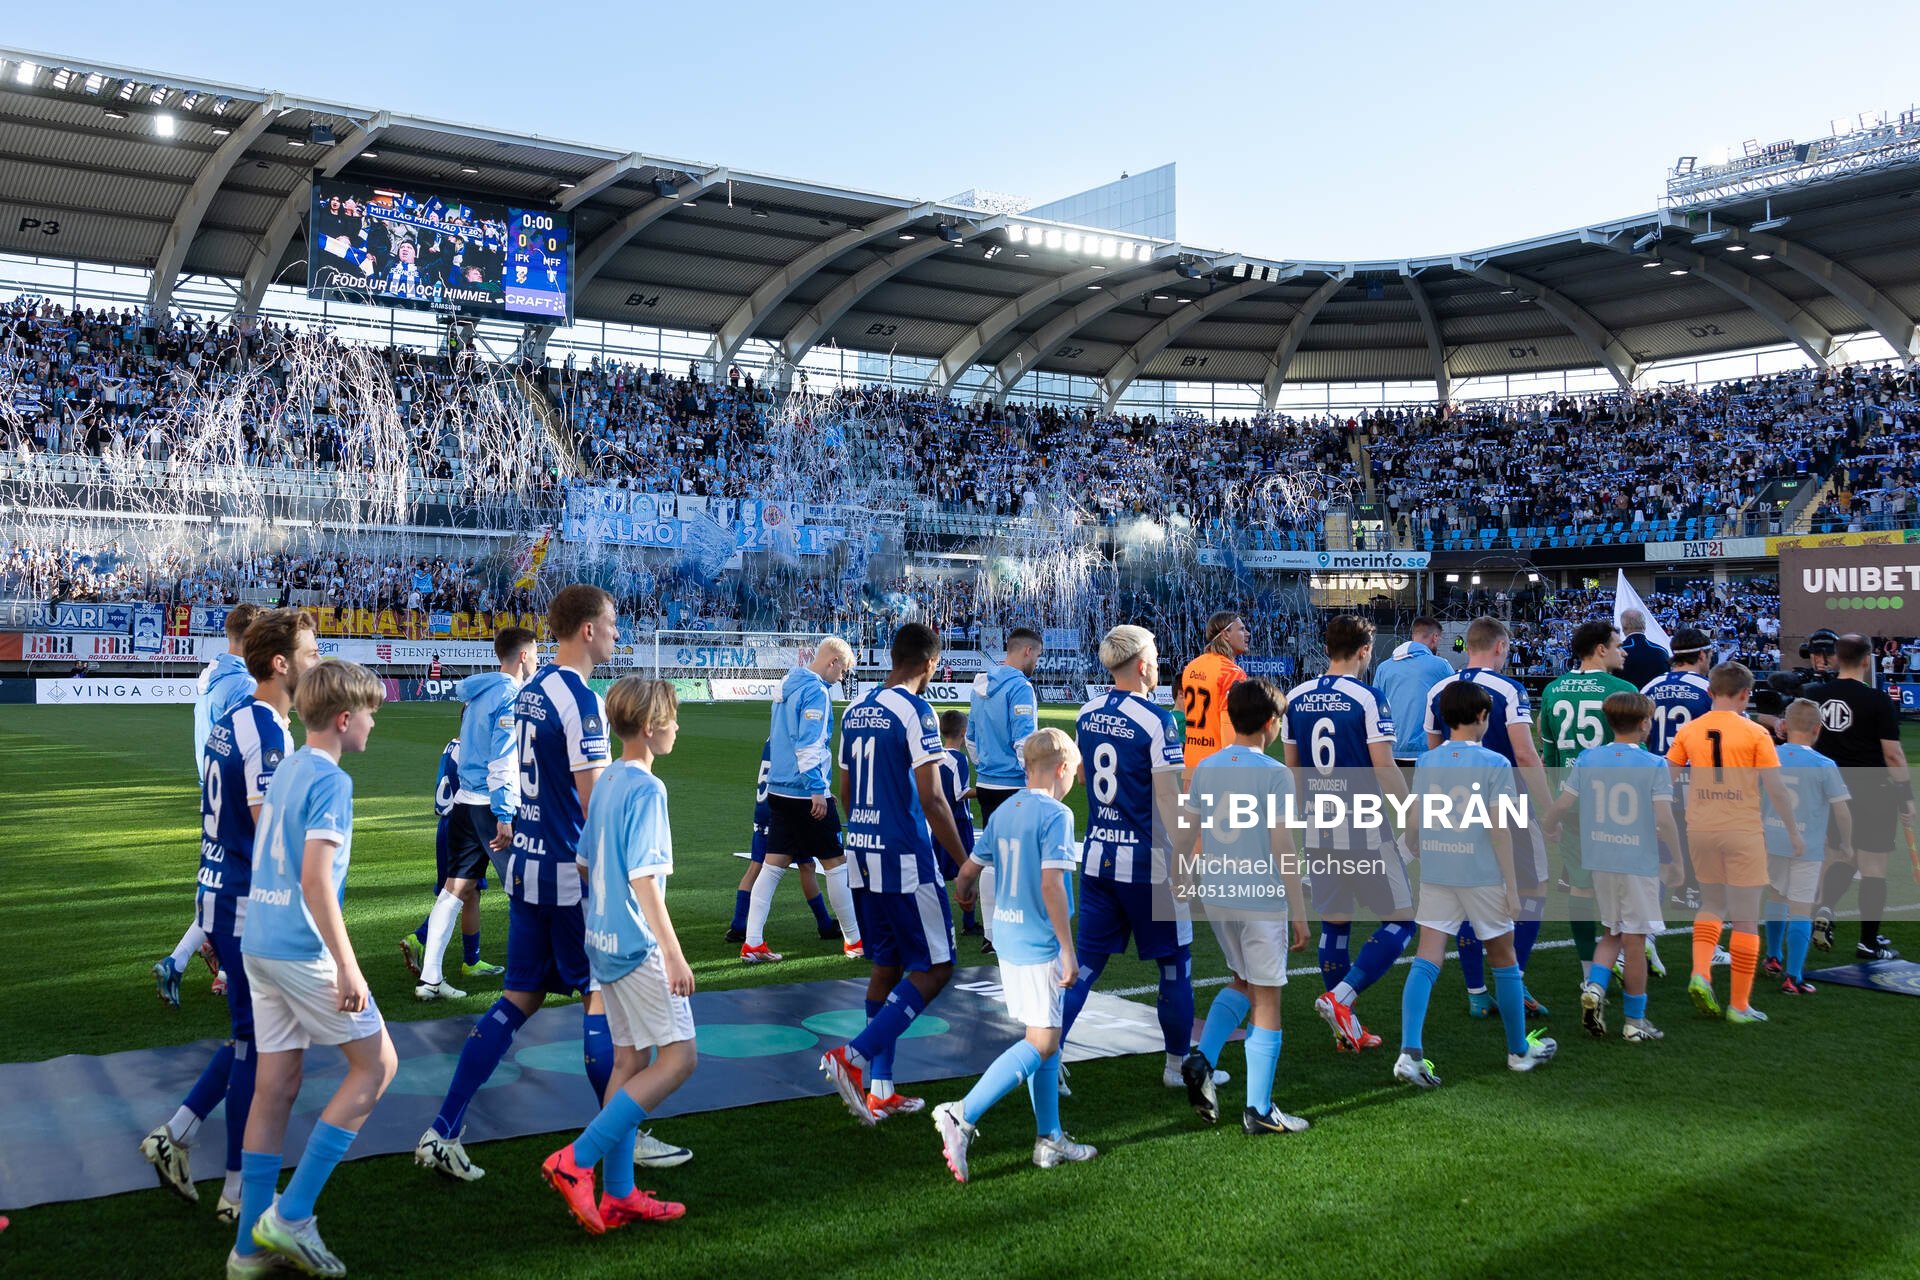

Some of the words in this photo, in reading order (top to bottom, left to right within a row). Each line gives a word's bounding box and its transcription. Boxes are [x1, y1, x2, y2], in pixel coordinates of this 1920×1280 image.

[370, 206, 391, 216] MITT
[19, 216, 60, 236] P3
[522, 213, 553, 231] 0:00
[518, 233, 527, 248] 0
[548, 237, 557, 252] 0
[515, 253, 530, 263] IFK
[543, 257, 561, 267] MFF
[332, 274, 367, 289] FÖDD
[369, 278, 387, 291] UR
[390, 282, 415, 295] HAV
[416, 284, 441, 297] OCH
[444, 287, 493, 303] HIMMEL
[430, 302, 461, 311] SAMSUNG
[505, 293, 553, 308] CRAFT
[625, 293, 659, 307] B4
[866, 323, 898, 336] B3
[1686, 324, 1725, 339] D2
[1509, 345, 1540, 359] D1
[1181, 356, 1209, 367] B1
[1759, 502, 1772, 512] D2
[1333, 553, 1426, 568] merinfo.se
[1803, 565, 1920, 593] UNIBET
[695, 647, 758, 668] STENA
[1237, 658, 1285, 673] ÖTEBORG
[1551, 685, 1606, 693] WELLNESS
[1561, 678, 1598, 686] NORDIC
[1654, 684, 1692, 693] NORDIC
[72, 685, 142, 697] VINGA
[1303, 692, 1342, 703] NORDIC
[1647, 691, 1700, 700] WELLNESS
[850, 706, 884, 718] NORDIC
[1184, 686, 1211, 729] 27
[1295, 702, 1352, 712] WELLNESS
[1089, 712, 1128, 728] NORDIC
[1821, 702, 1850, 729] MG
[844, 718, 891, 729] WELLNESS
[1081, 721, 1135, 739] WELLNESS
[1552, 699, 1604, 750] 25
[1311, 717, 1336, 776] 6
[1707, 730, 1723, 784] 1
[851, 736, 876, 806] 11
[1093, 742, 1118, 806] 8
[1307, 779, 1348, 792] TRONDSEN
[1591, 779, 1639, 826] 10
[1591, 830, 1641, 847] tillmobil
[1421, 839, 1475, 855] tillmobil
[997, 837, 1021, 897] 11
